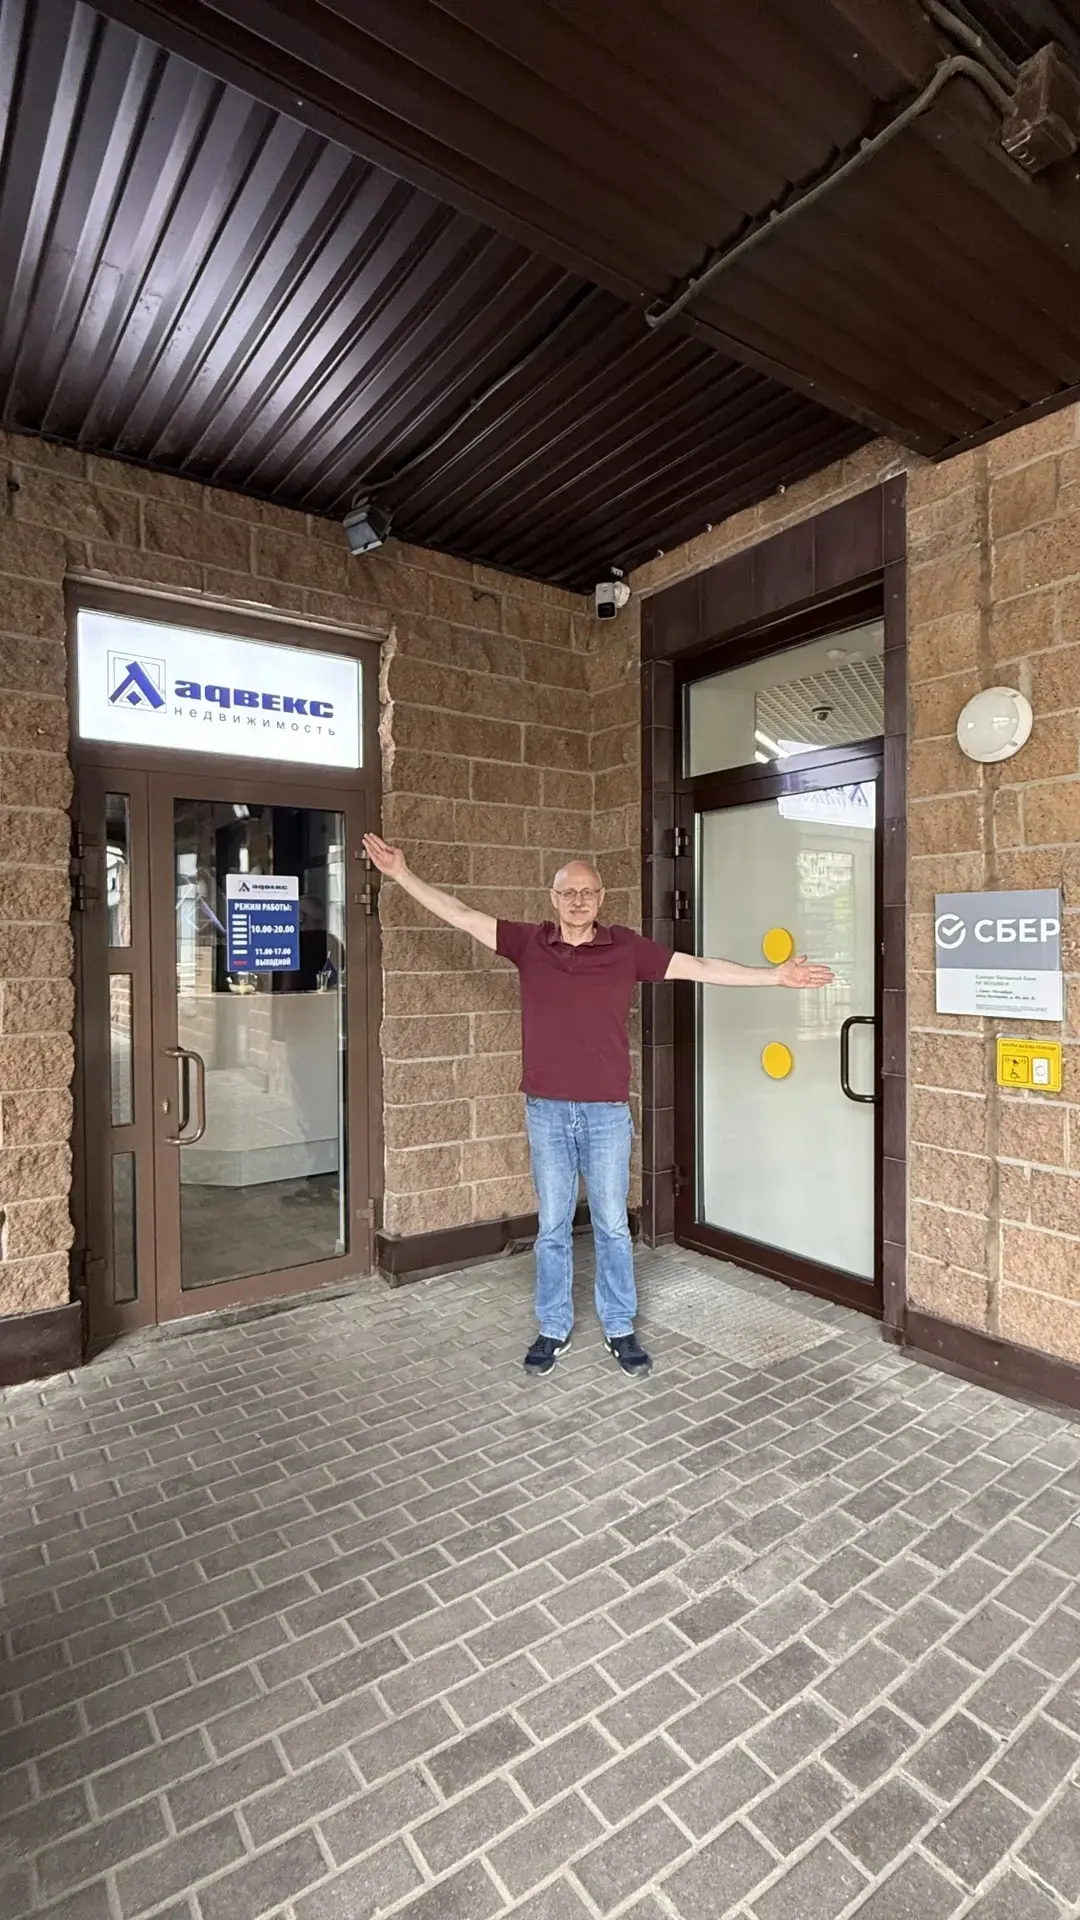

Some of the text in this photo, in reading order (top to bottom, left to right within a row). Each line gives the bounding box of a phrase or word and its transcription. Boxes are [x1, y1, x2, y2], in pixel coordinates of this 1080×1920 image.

[174, 706, 336, 736] недвижимость
[234, 902, 292, 911] РЕЖИМ РАБОТЫ:
[251, 925, 295, 934] 10.00-20.00
[974, 917, 1060, 943] СБЕР
[255, 957, 291, 966] ВЫХОДНОЙ
